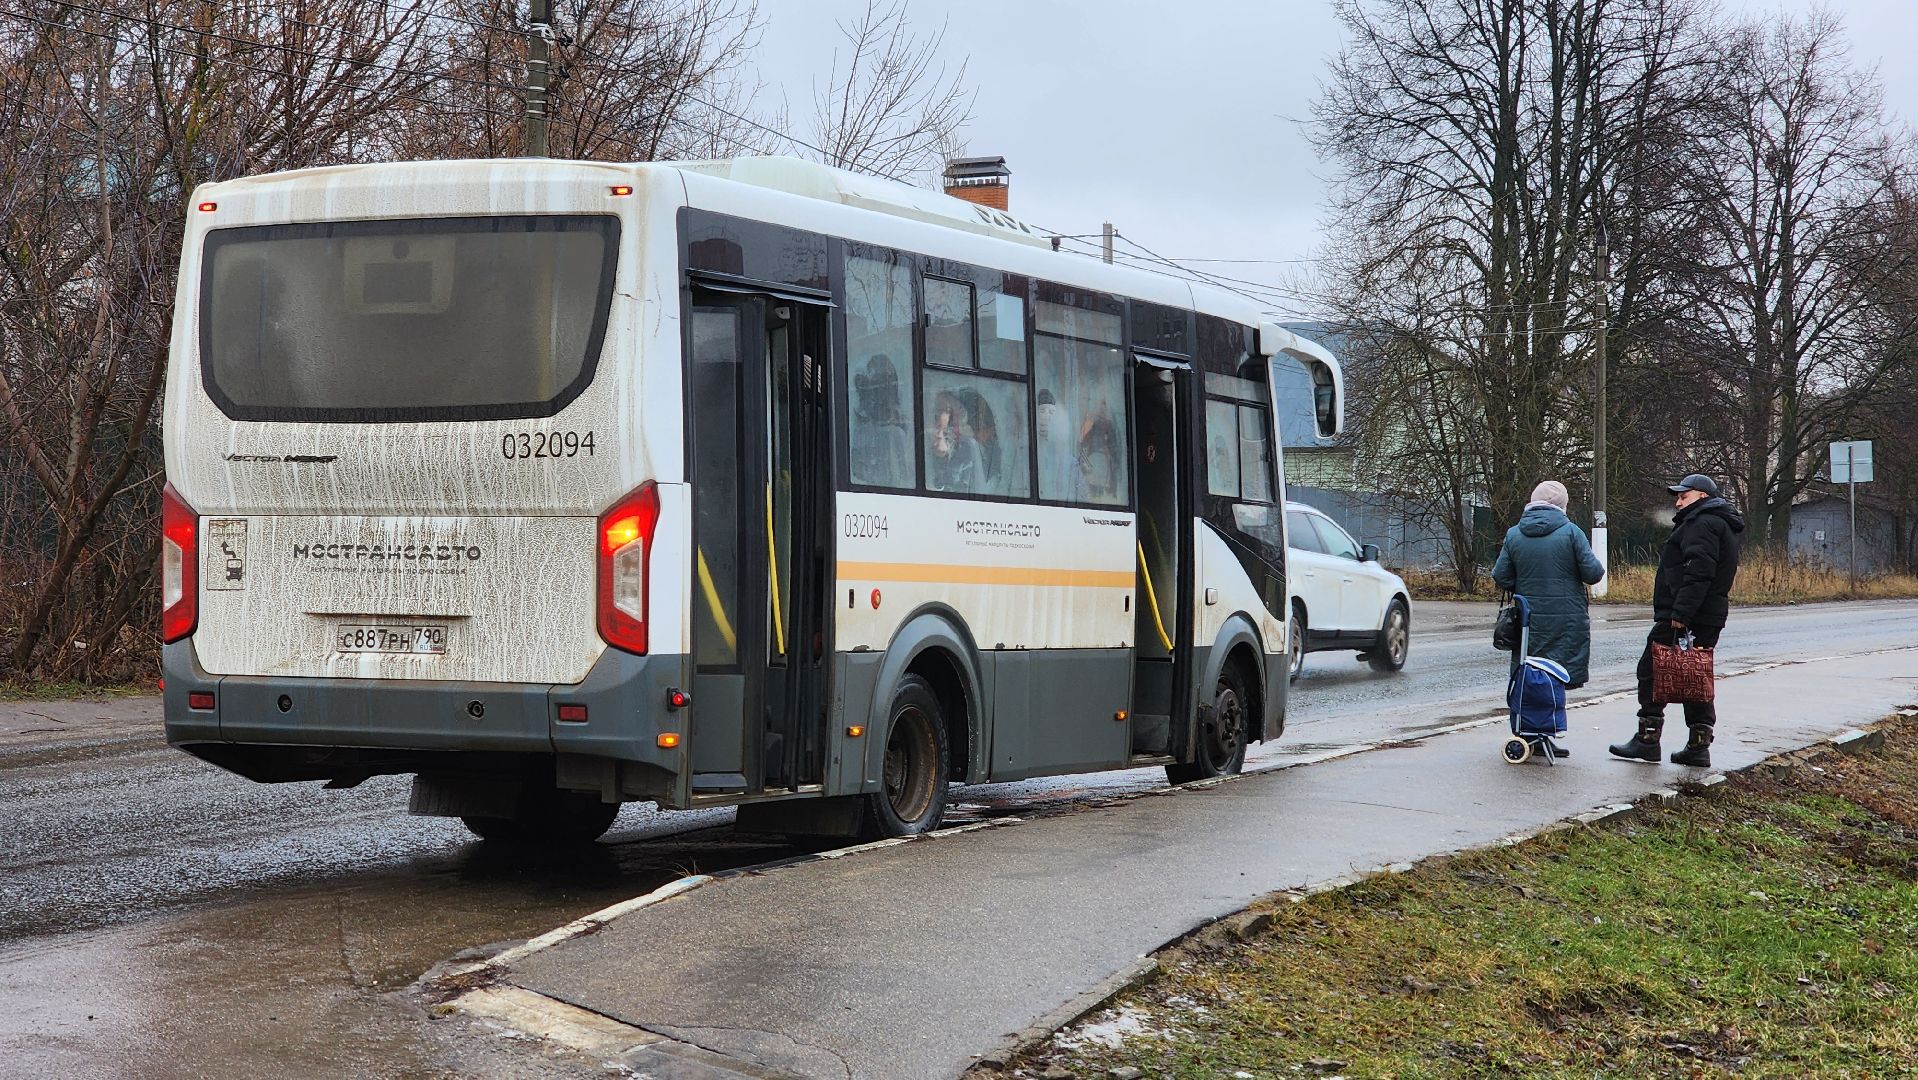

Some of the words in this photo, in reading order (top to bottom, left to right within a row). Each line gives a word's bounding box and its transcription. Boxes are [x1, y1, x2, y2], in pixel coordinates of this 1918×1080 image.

[502, 431, 596, 459] 032094
[844, 513, 889, 539] 032094
[956, 520, 1041, 537] МОСТРАНСАВТО
[293, 543, 482, 561] МОСТРАНСАВТО
[414, 628, 442, 645] 790
